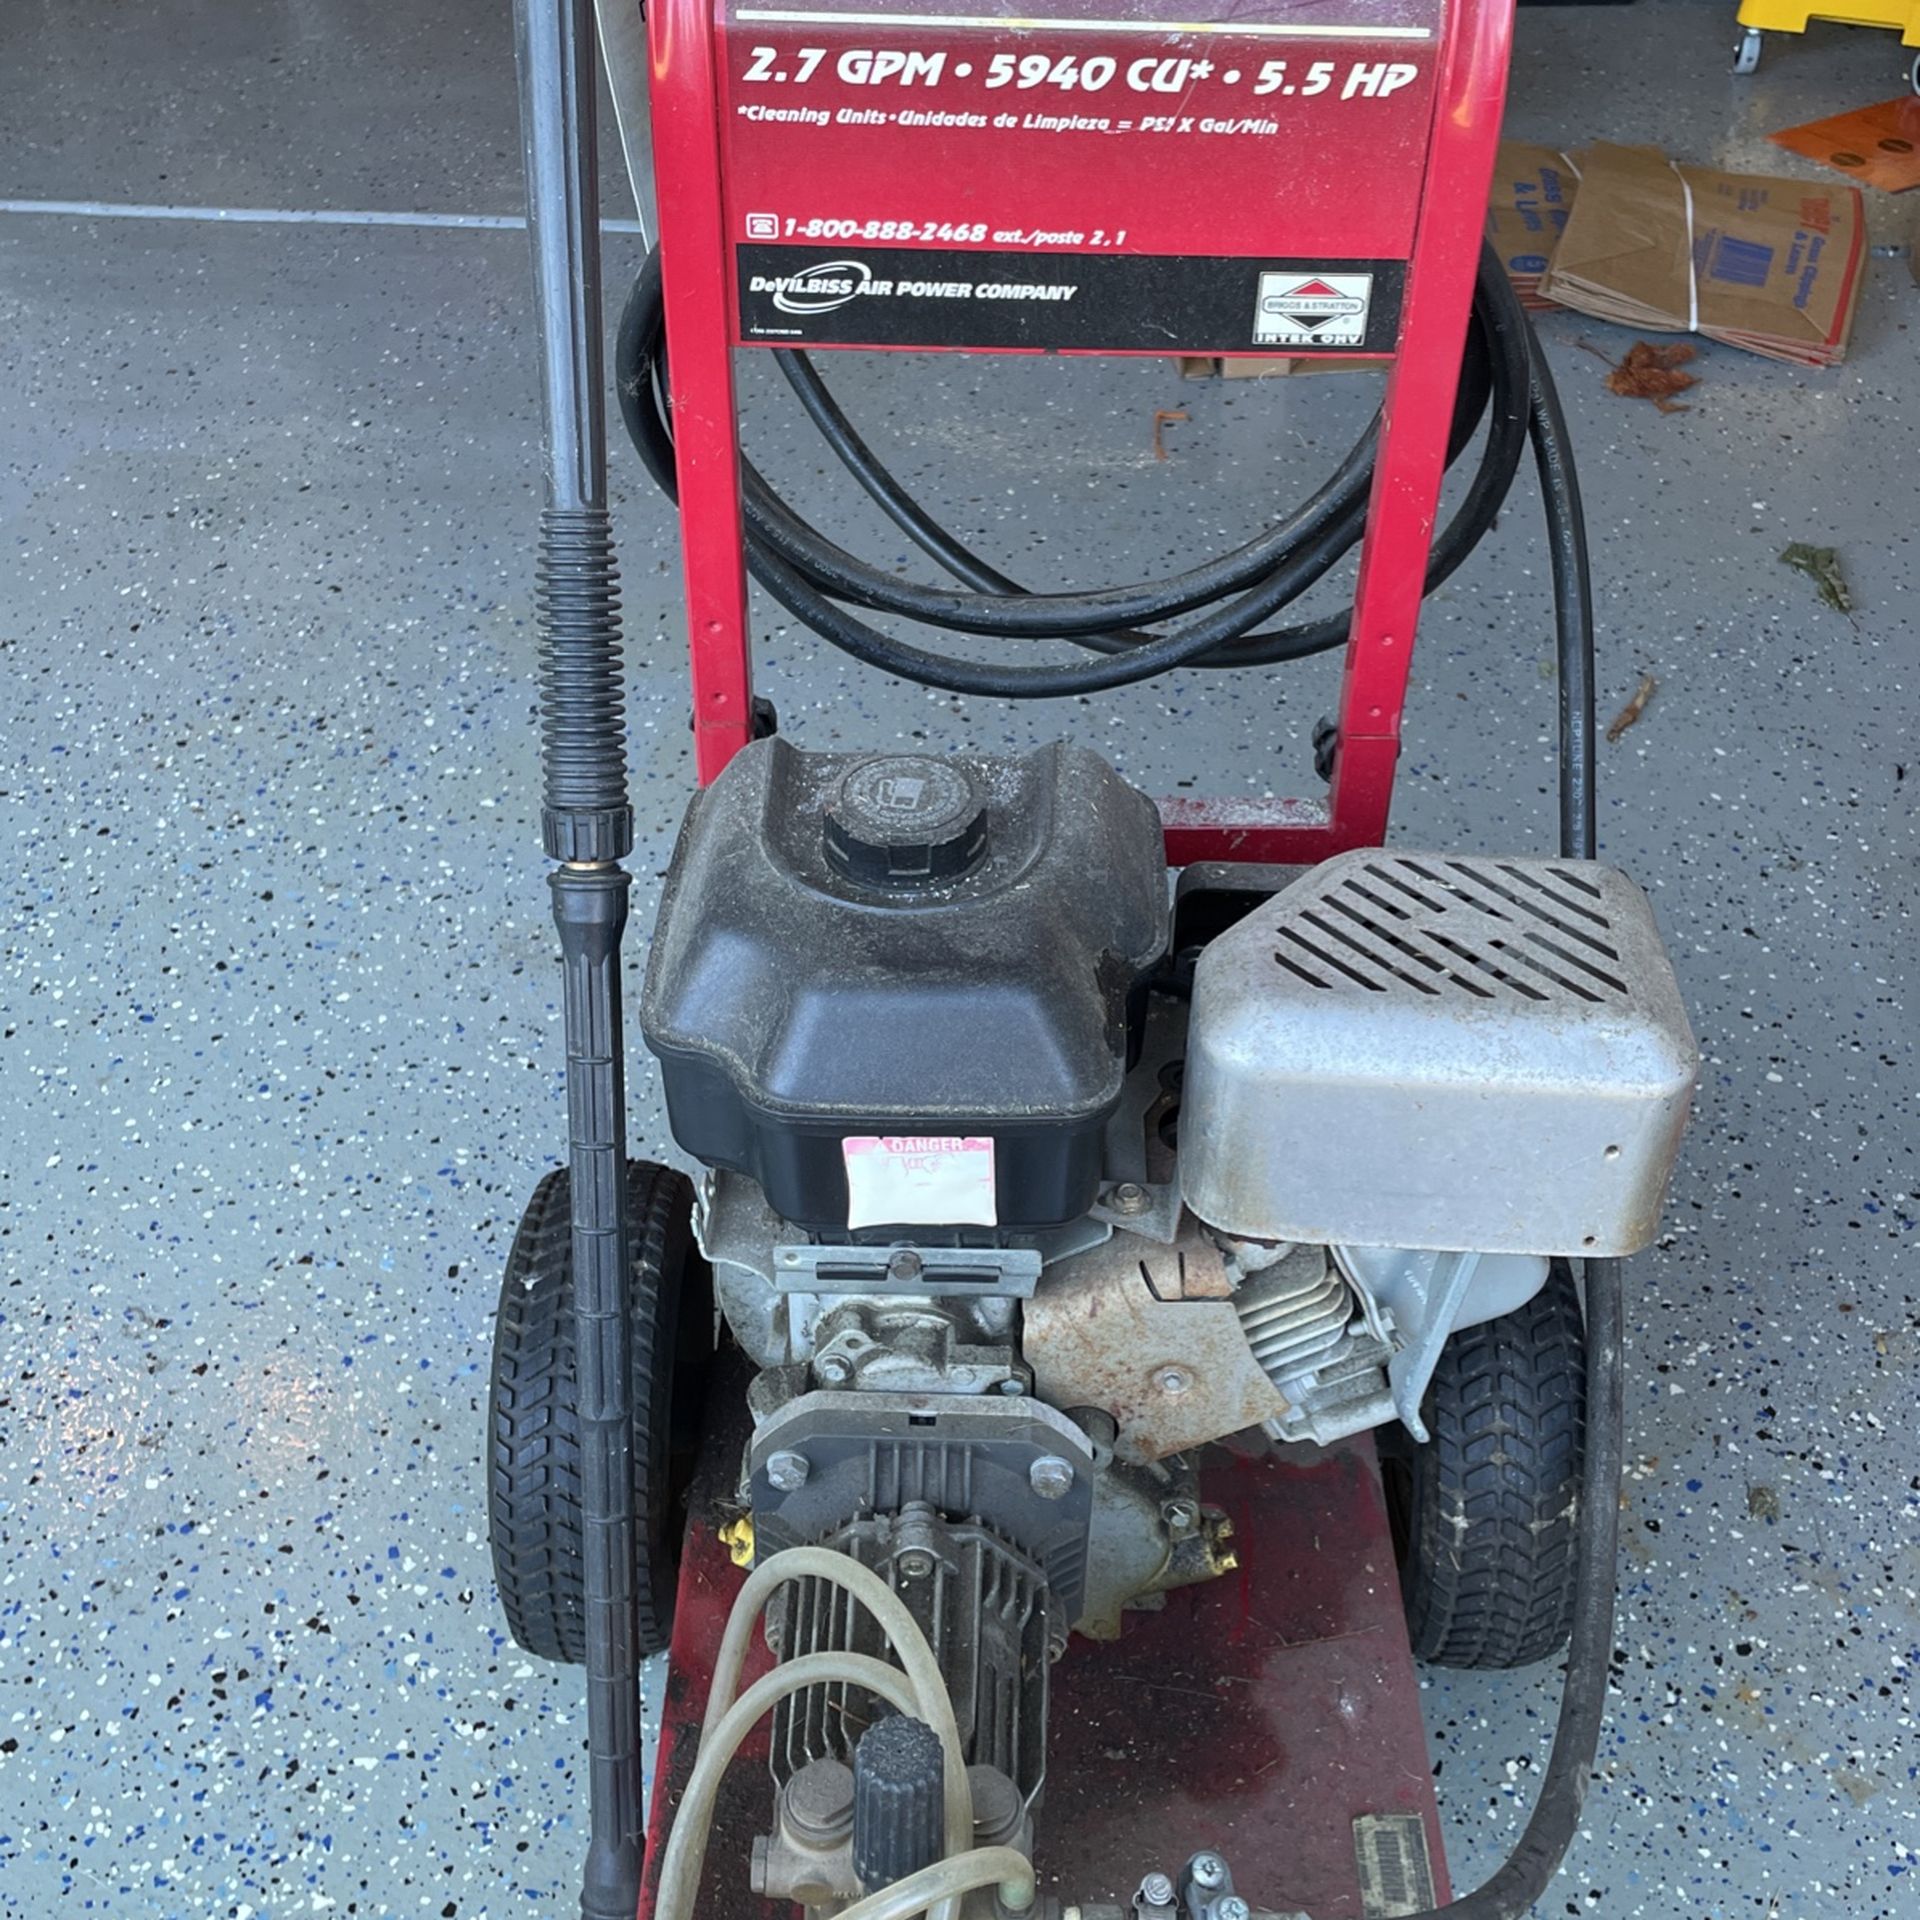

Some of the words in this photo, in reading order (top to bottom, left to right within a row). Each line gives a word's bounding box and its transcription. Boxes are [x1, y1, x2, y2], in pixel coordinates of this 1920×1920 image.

[742, 47, 827, 82] 2.7
[837, 50, 947, 86] GPM
[985, 54, 1117, 91] 5940
[1254, 61, 1335, 96] 5.5
[1340, 63, 1418, 100] HP
[993, 113, 1018, 129] de
[1022, 114, 1109, 132] Limpieza
[1177, 118, 1195, 133] X
[1199, 118, 1279, 135] Gal/Min
[784, 218, 988, 243] 1-800-888-2468
[750, 277, 852, 295] DeVILBISS
[855, 279, 892, 296] AIR
[896, 281, 971, 298] POWER
[975, 284, 1077, 300] COMPANY
[1267, 301, 1302, 309] BRIGGS
[1304, 301, 1311, 310] &
[1312, 301, 1358, 310] STRATTON
[891, 1139, 964, 1152] DANGER
